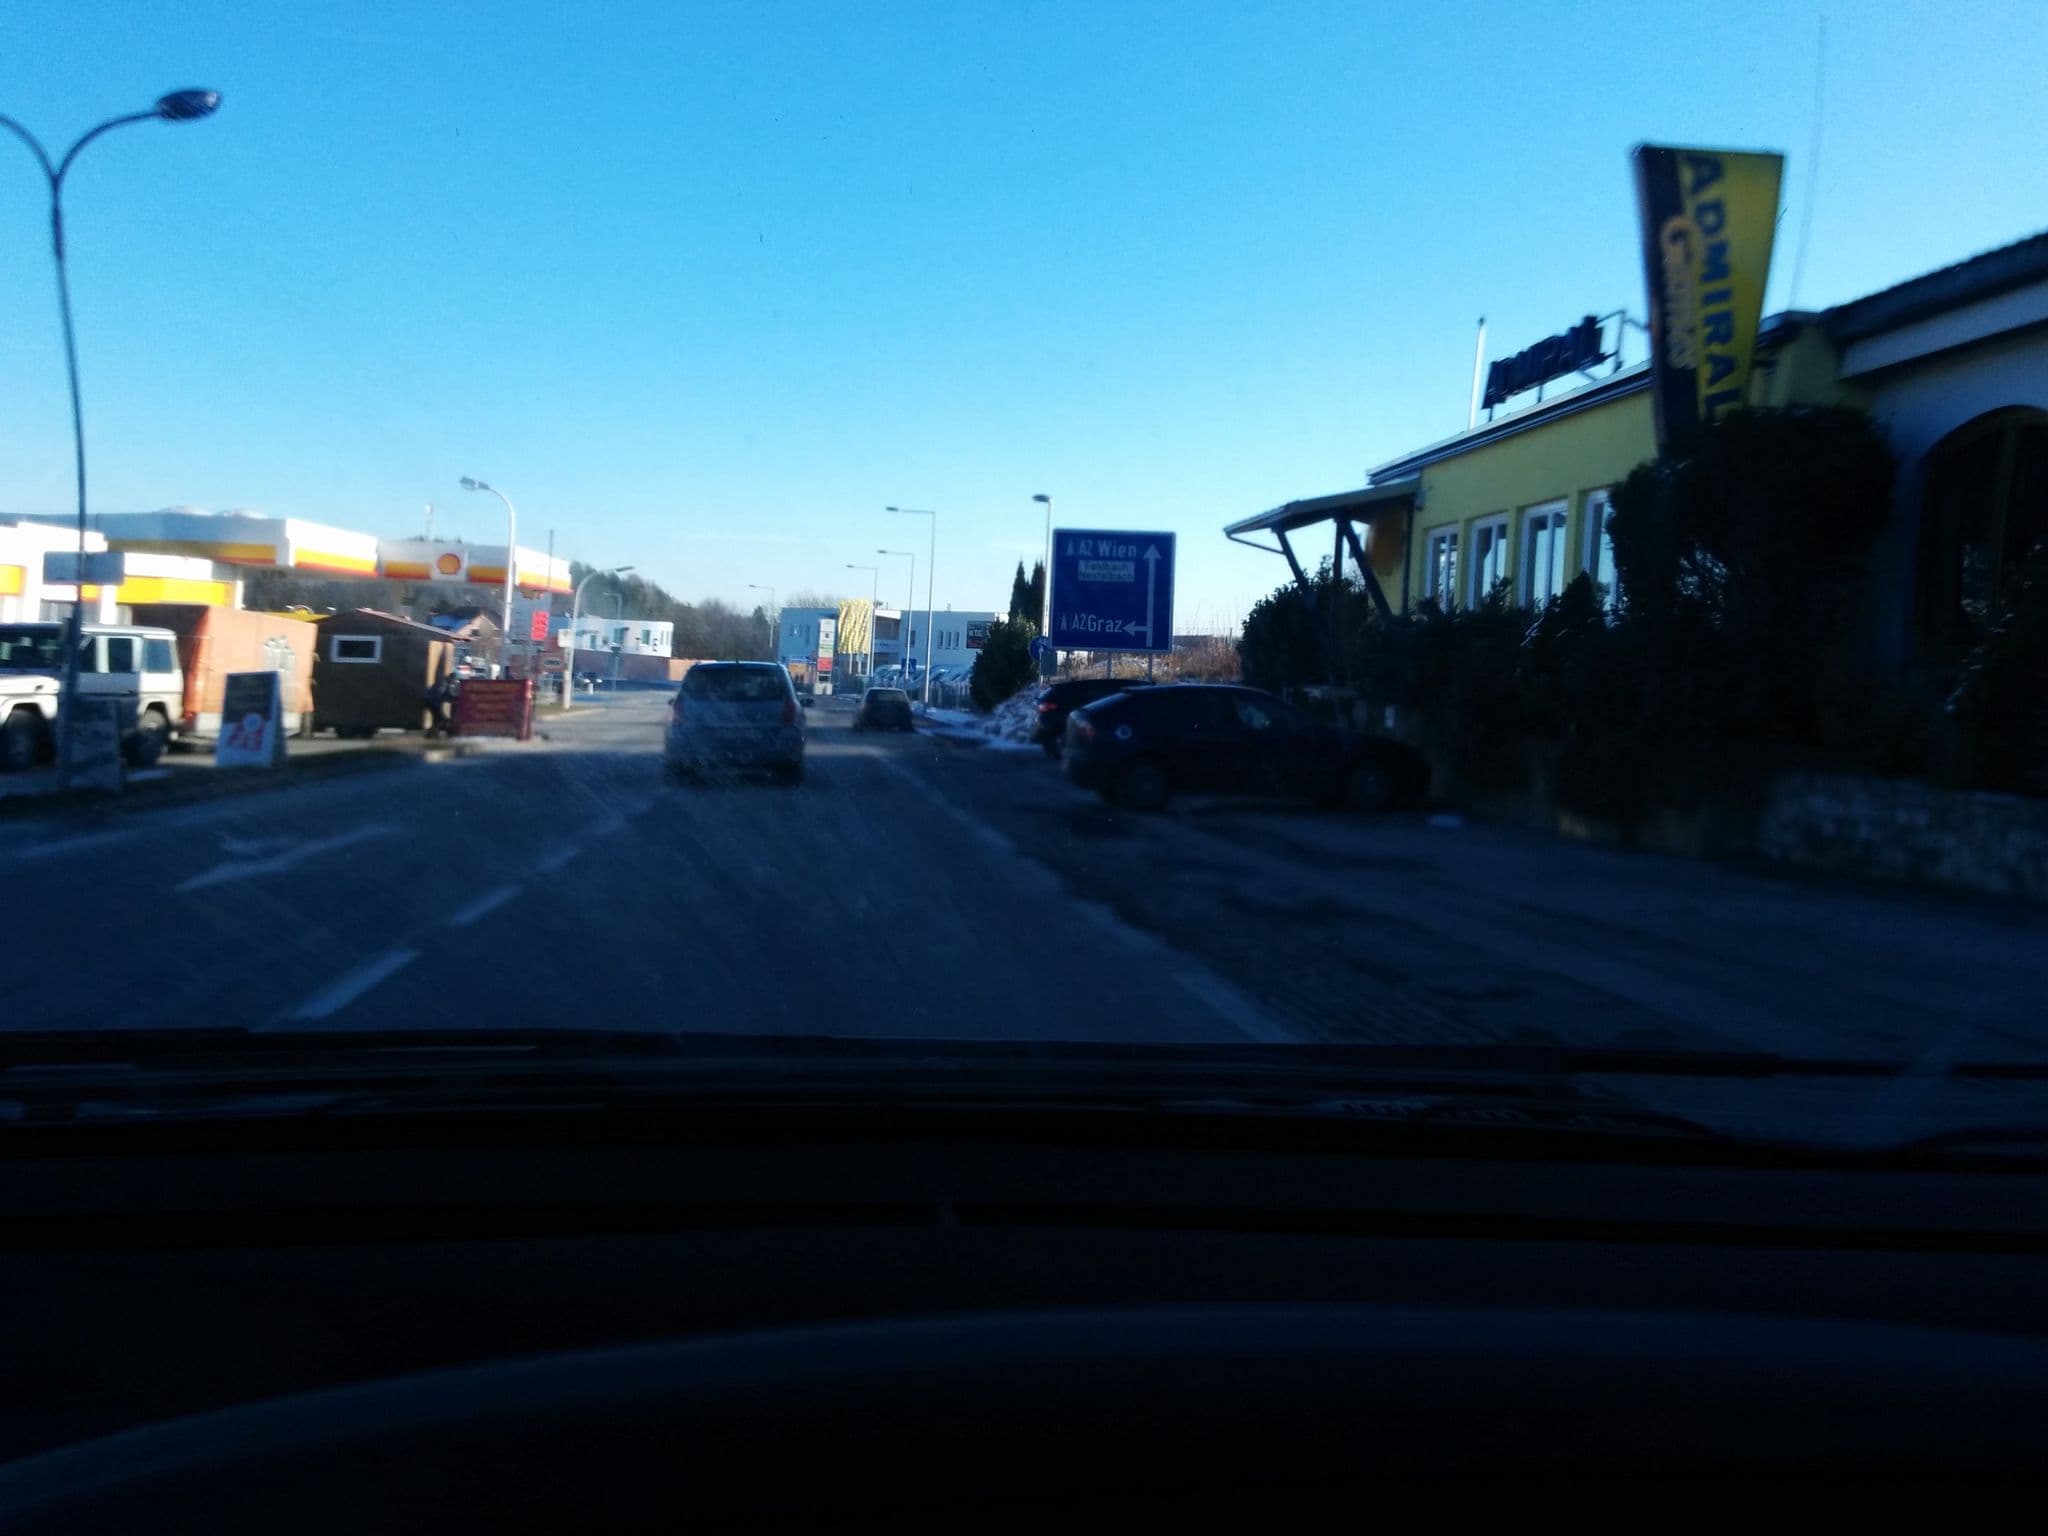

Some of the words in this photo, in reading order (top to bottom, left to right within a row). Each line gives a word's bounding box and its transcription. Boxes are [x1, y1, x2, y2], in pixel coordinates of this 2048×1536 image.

[1686, 155, 1742, 420] ADMIRAL
[1097, 538, 1137, 559] Wien
[1072, 612, 1086, 630] A2
[1088, 613, 1123, 633] Graz
